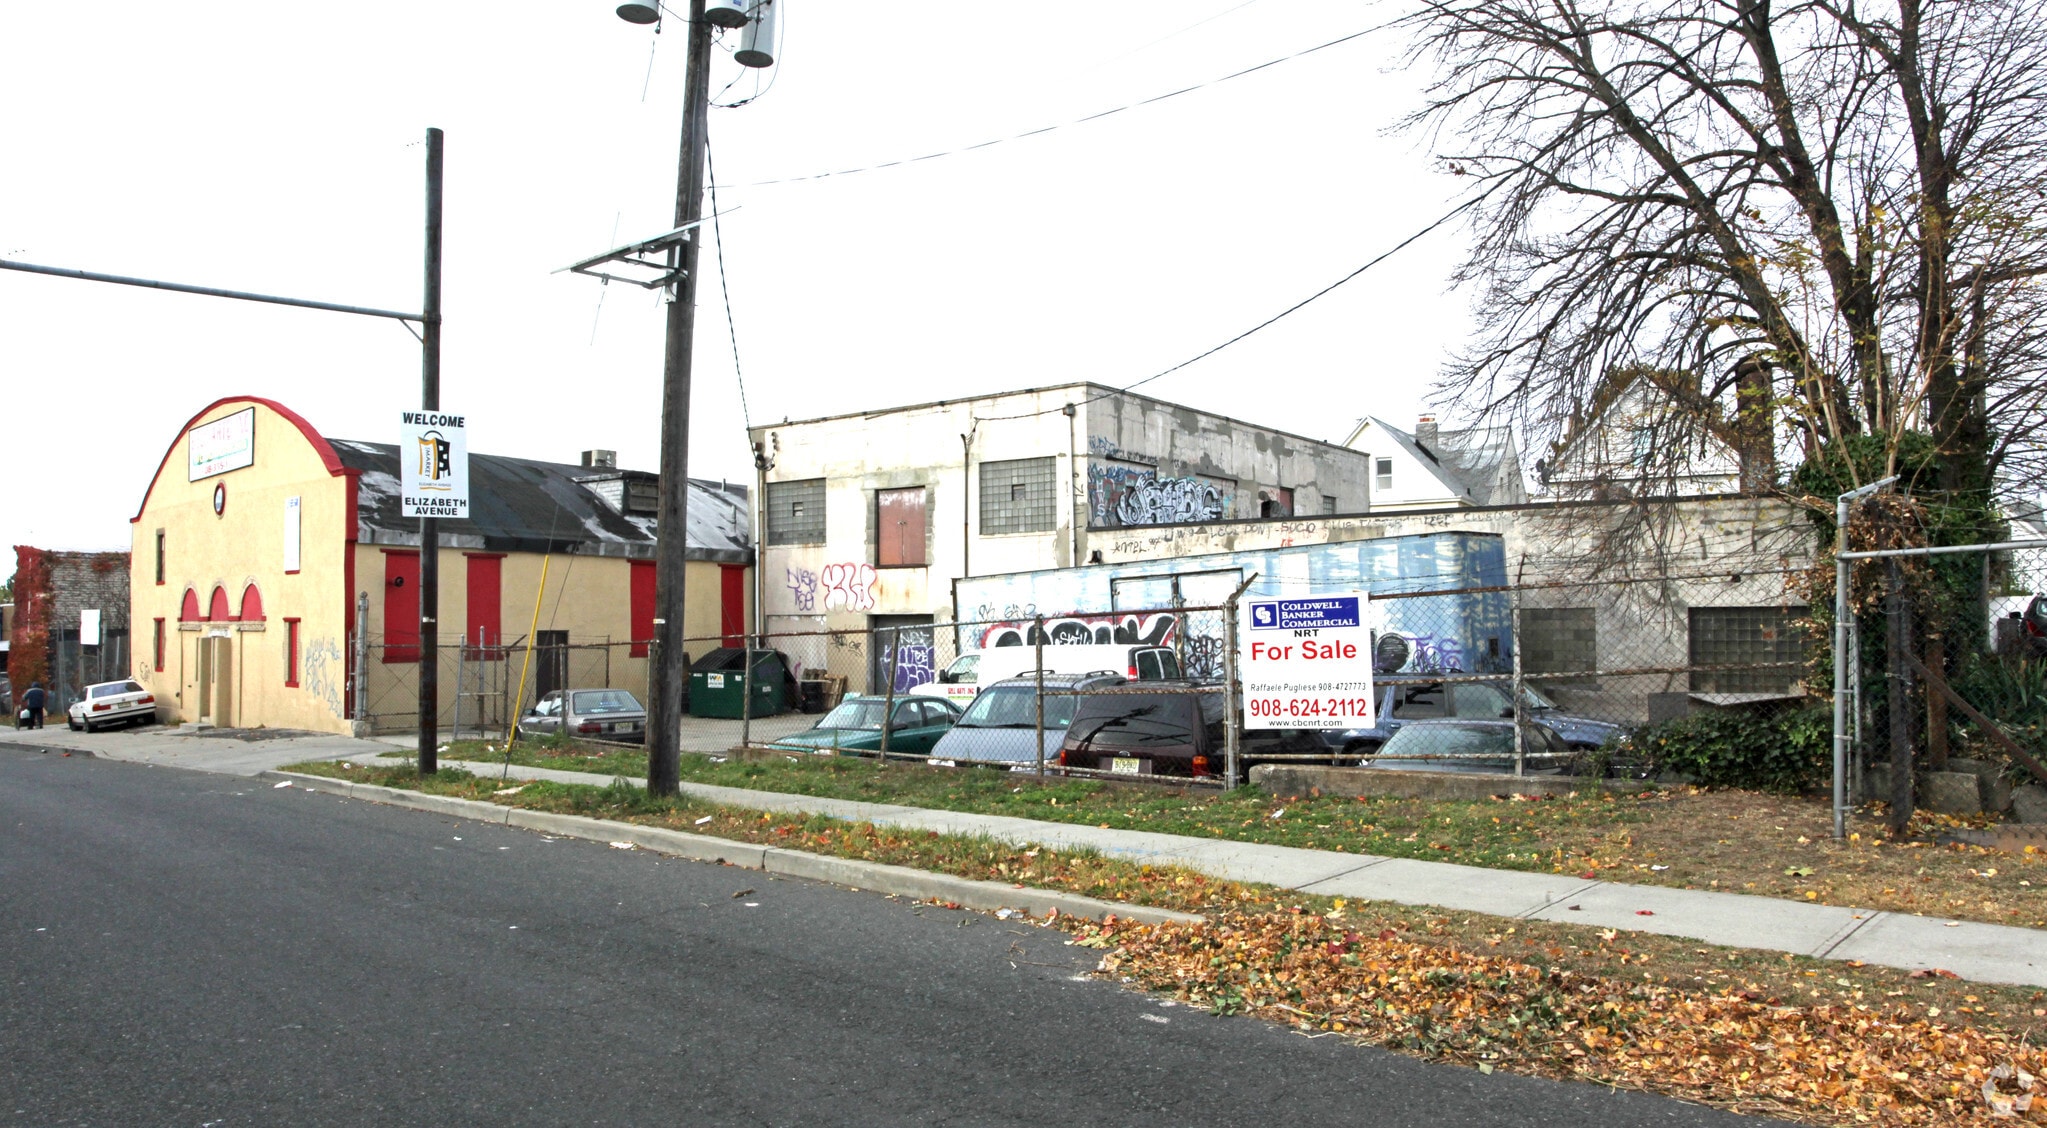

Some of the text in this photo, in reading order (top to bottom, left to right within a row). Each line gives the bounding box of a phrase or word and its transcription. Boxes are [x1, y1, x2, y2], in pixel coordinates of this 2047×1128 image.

[403, 412, 465, 428] WELCOME
[404, 497, 467, 507] ELIZABETH
[415, 507, 458, 515] AVENUE
[1281, 602, 1343, 611] COLDWELL
[1281, 611, 1325, 620] BANKER
[1281, 619, 1356, 628] COMMERCIAL
[1294, 629, 1320, 638] NRT
[1252, 640, 1357, 661] For Sale
[1250, 682, 1367, 693] Raffaele Pugliese 908-4727773
[1250, 698, 1367, 717] 908-624-2112
[1268, 719, 1343, 727] www.cbcnrt.com
